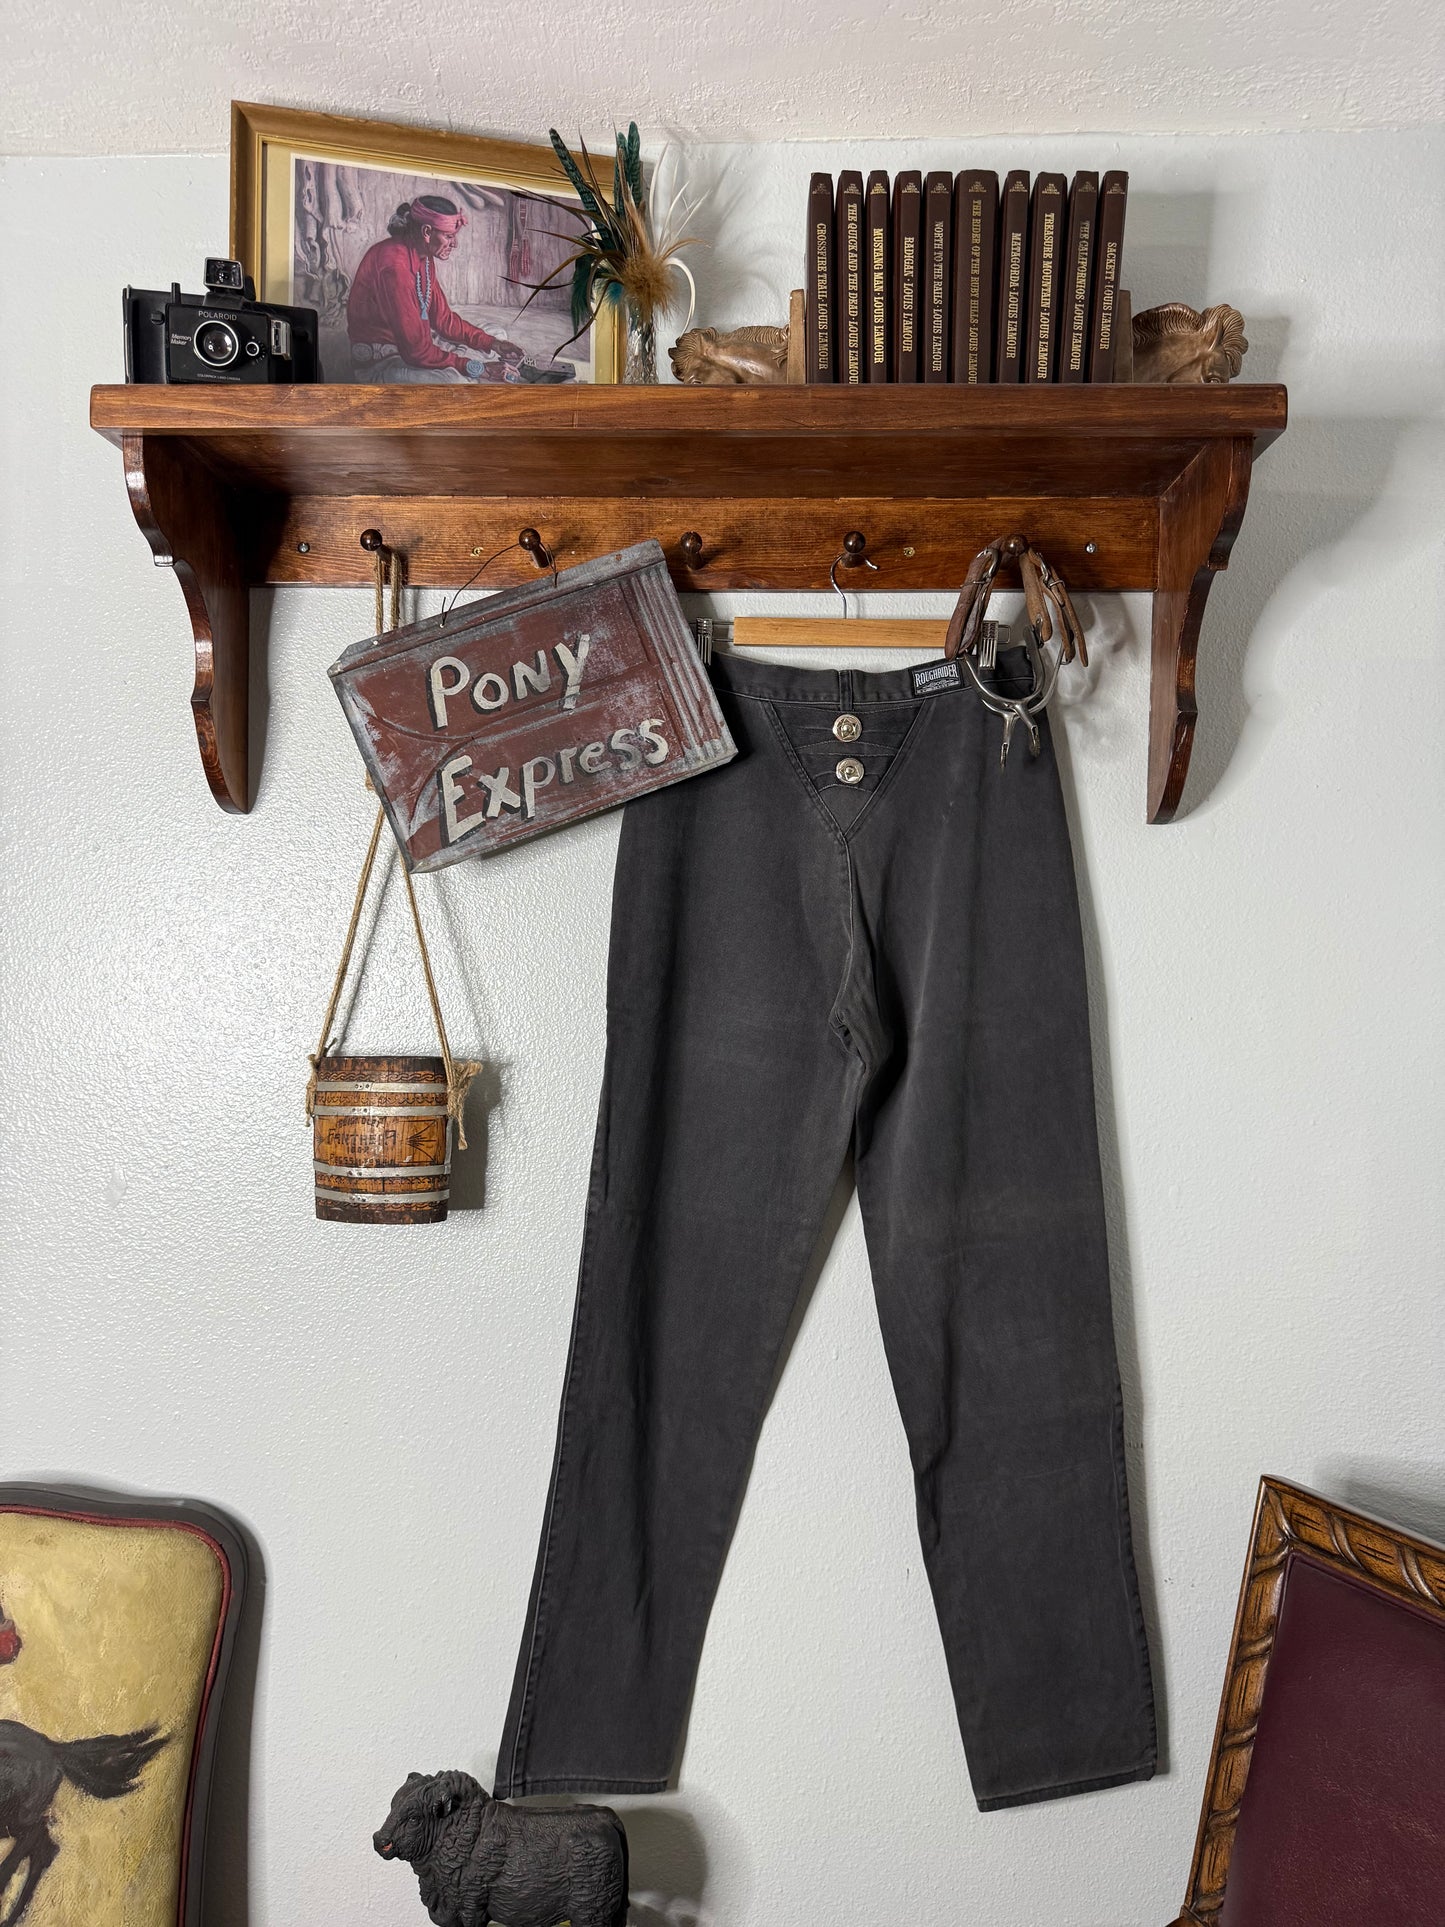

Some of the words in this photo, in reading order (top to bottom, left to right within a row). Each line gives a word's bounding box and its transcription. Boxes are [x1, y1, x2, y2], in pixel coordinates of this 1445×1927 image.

[848, 204, 857, 221] THE
[973, 200, 981, 216] THE
[848, 223, 857, 251] QUICK
[934, 221, 943, 248] NORTH
[972, 219, 981, 243] RIDER
[1043, 213, 1054, 258] TREASURE
[1080, 221, 1089, 239] THE
[817, 223, 826, 271] CROSSFIRE
[874, 228, 883, 269] MUSTANG
[904, 237, 914, 277] RADIGAN
[934, 251, 943, 261] TO
[972, 246, 980, 257] OF
[849, 253, 857, 271] AND
[934, 263, 942, 279] THE
[971, 258, 980, 274] THE
[1010, 233, 1021, 288] MATAGORDA
[1076, 241, 1088, 300] CALIFORNIOS
[1105, 242, 1116, 281] SACKETT
[818, 274, 827, 299] TRAIL
[849, 273, 857, 290] THE
[874, 272, 883, 292] MAN
[934, 282, 942, 304] RAILS
[971, 277, 979, 297] RUBY
[1041, 261, 1052, 307] MOUNTAIN
[849, 293, 857, 317] DEAD
[903, 283, 913, 309] LOUIS
[1009, 292, 1018, 318] LOUIS
[1103, 285, 1113, 310] LOUIS
[198, 310, 237, 321] POLAROID
[818, 304, 827, 329] LOUIS
[874, 297, 883, 322] LOUIS
[933, 309, 942, 333] LOUIS
[970, 299, 978, 324] HILLS
[1074, 304, 1084, 330] LOUIS
[171, 333, 192, 342] Memory
[849, 321, 858, 347] LOUIS
[1040, 312, 1049, 338] LOUIS
[170, 338, 187, 346] Maker
[969, 327, 978, 351] LOUIS
[849, 350, 858, 384] L'AMOU
[969, 354, 977, 384] L'AMOU
[915, 664, 959, 687] ROUGHRIDER
[439, 717, 669, 845] Express
